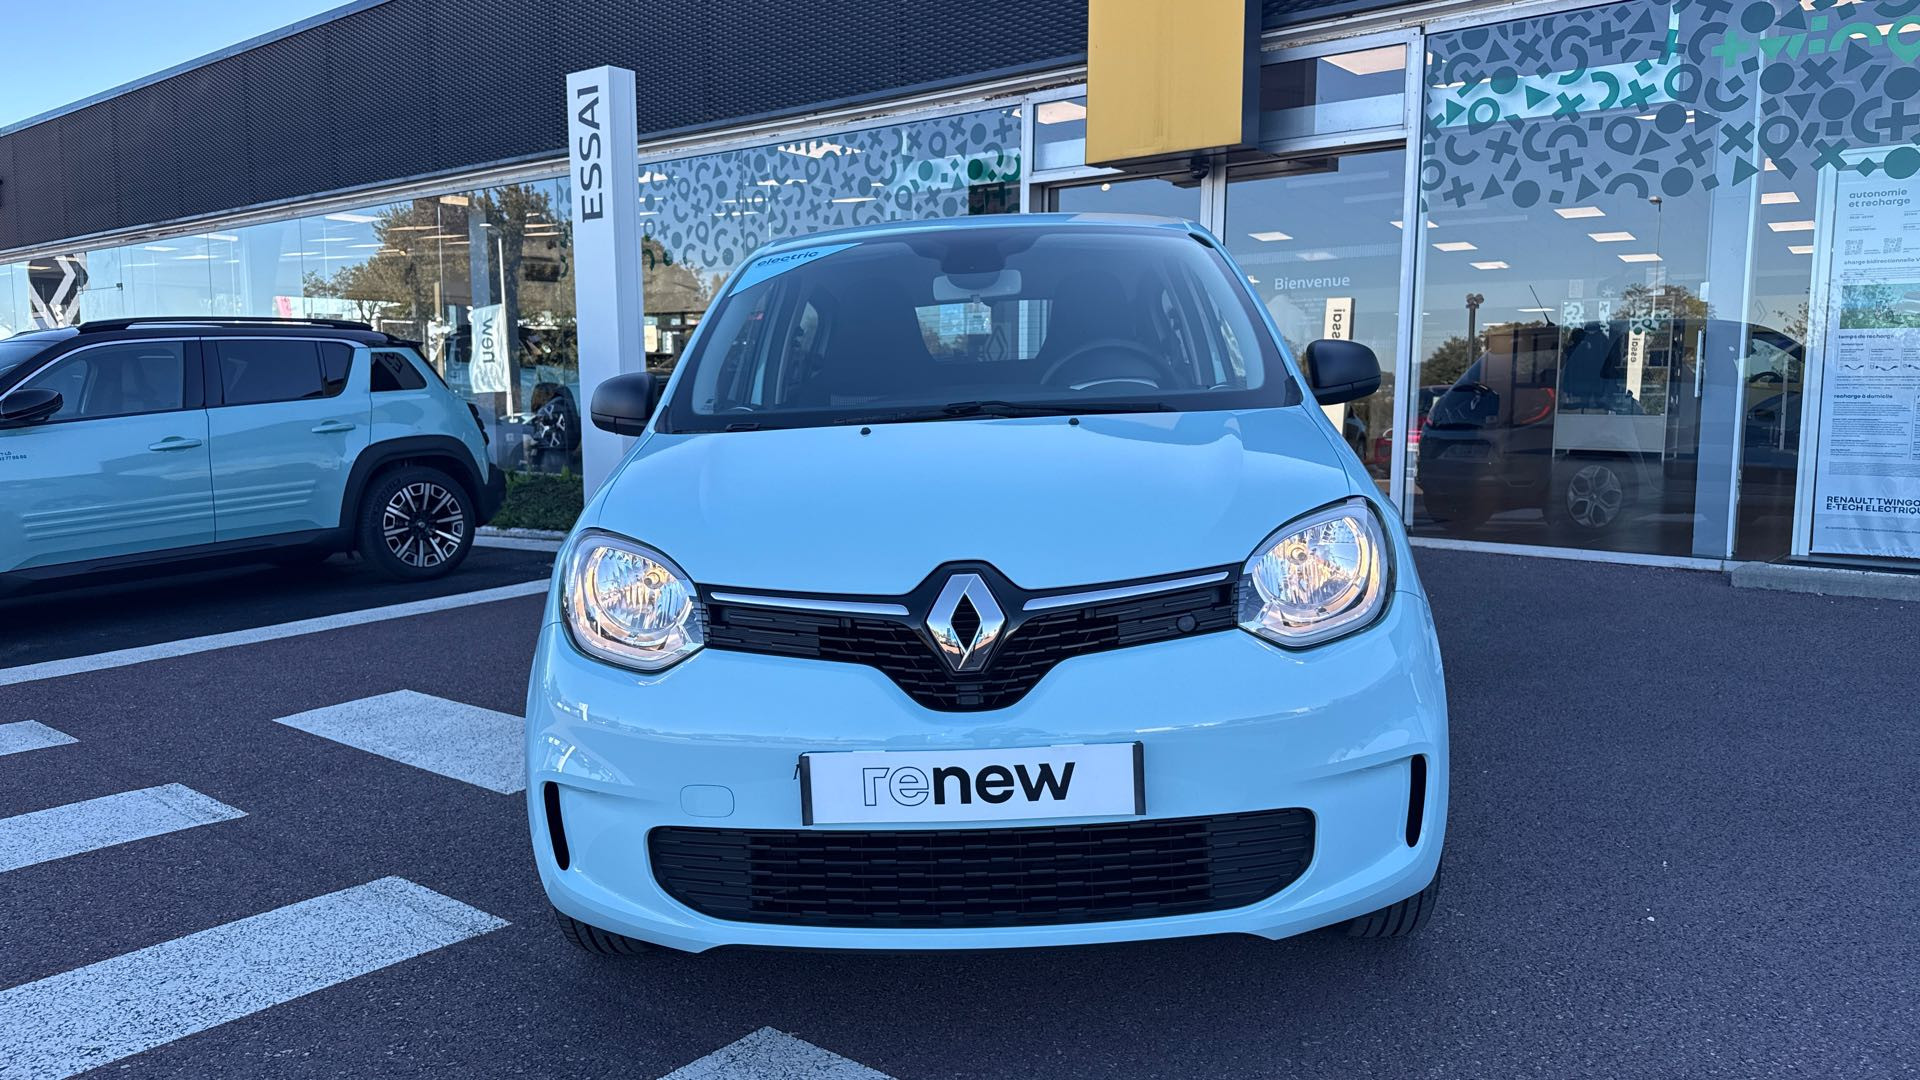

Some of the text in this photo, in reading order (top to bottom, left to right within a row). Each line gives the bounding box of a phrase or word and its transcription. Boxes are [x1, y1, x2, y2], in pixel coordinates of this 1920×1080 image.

[577, 85, 603, 223] ESSAI
[1849, 188, 1908, 199] autonomie
[1848, 198, 1911, 208] et recharge
[757, 251, 819, 267] electric
[1274, 276, 1351, 291] Bienvenue
[1826, 495, 1920, 507] RENAULT TWINGO
[1826, 503, 1863, 512] E-TECH
[863, 762, 1075, 807] renew
